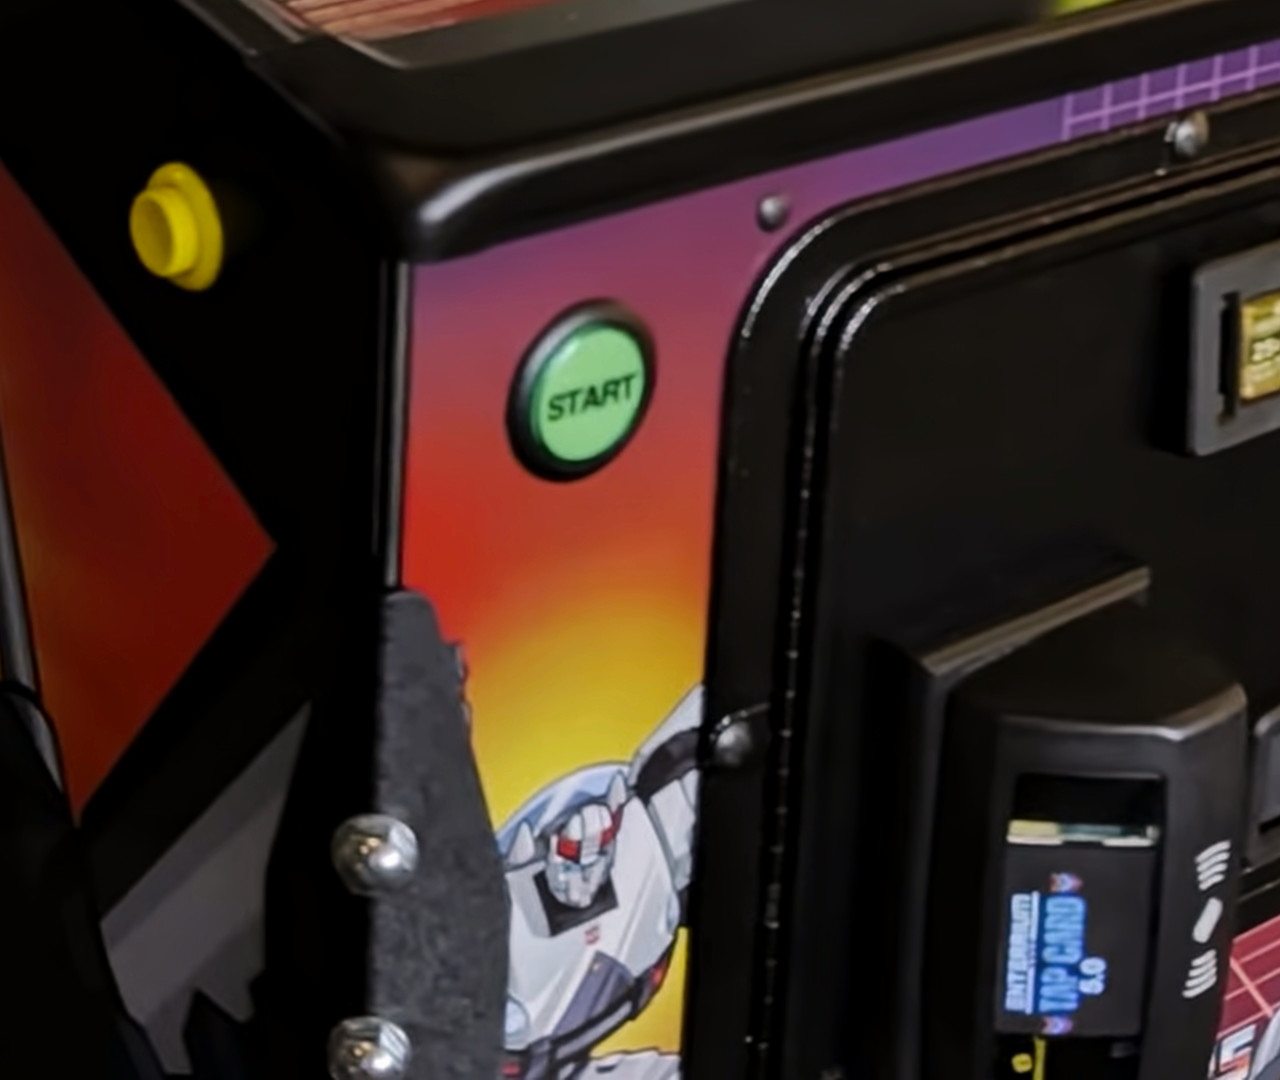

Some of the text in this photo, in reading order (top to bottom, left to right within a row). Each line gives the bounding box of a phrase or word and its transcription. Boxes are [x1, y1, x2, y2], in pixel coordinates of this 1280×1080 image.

[547, 374, 636, 421] START
[1039, 896, 1085, 1013] TAP CARD
